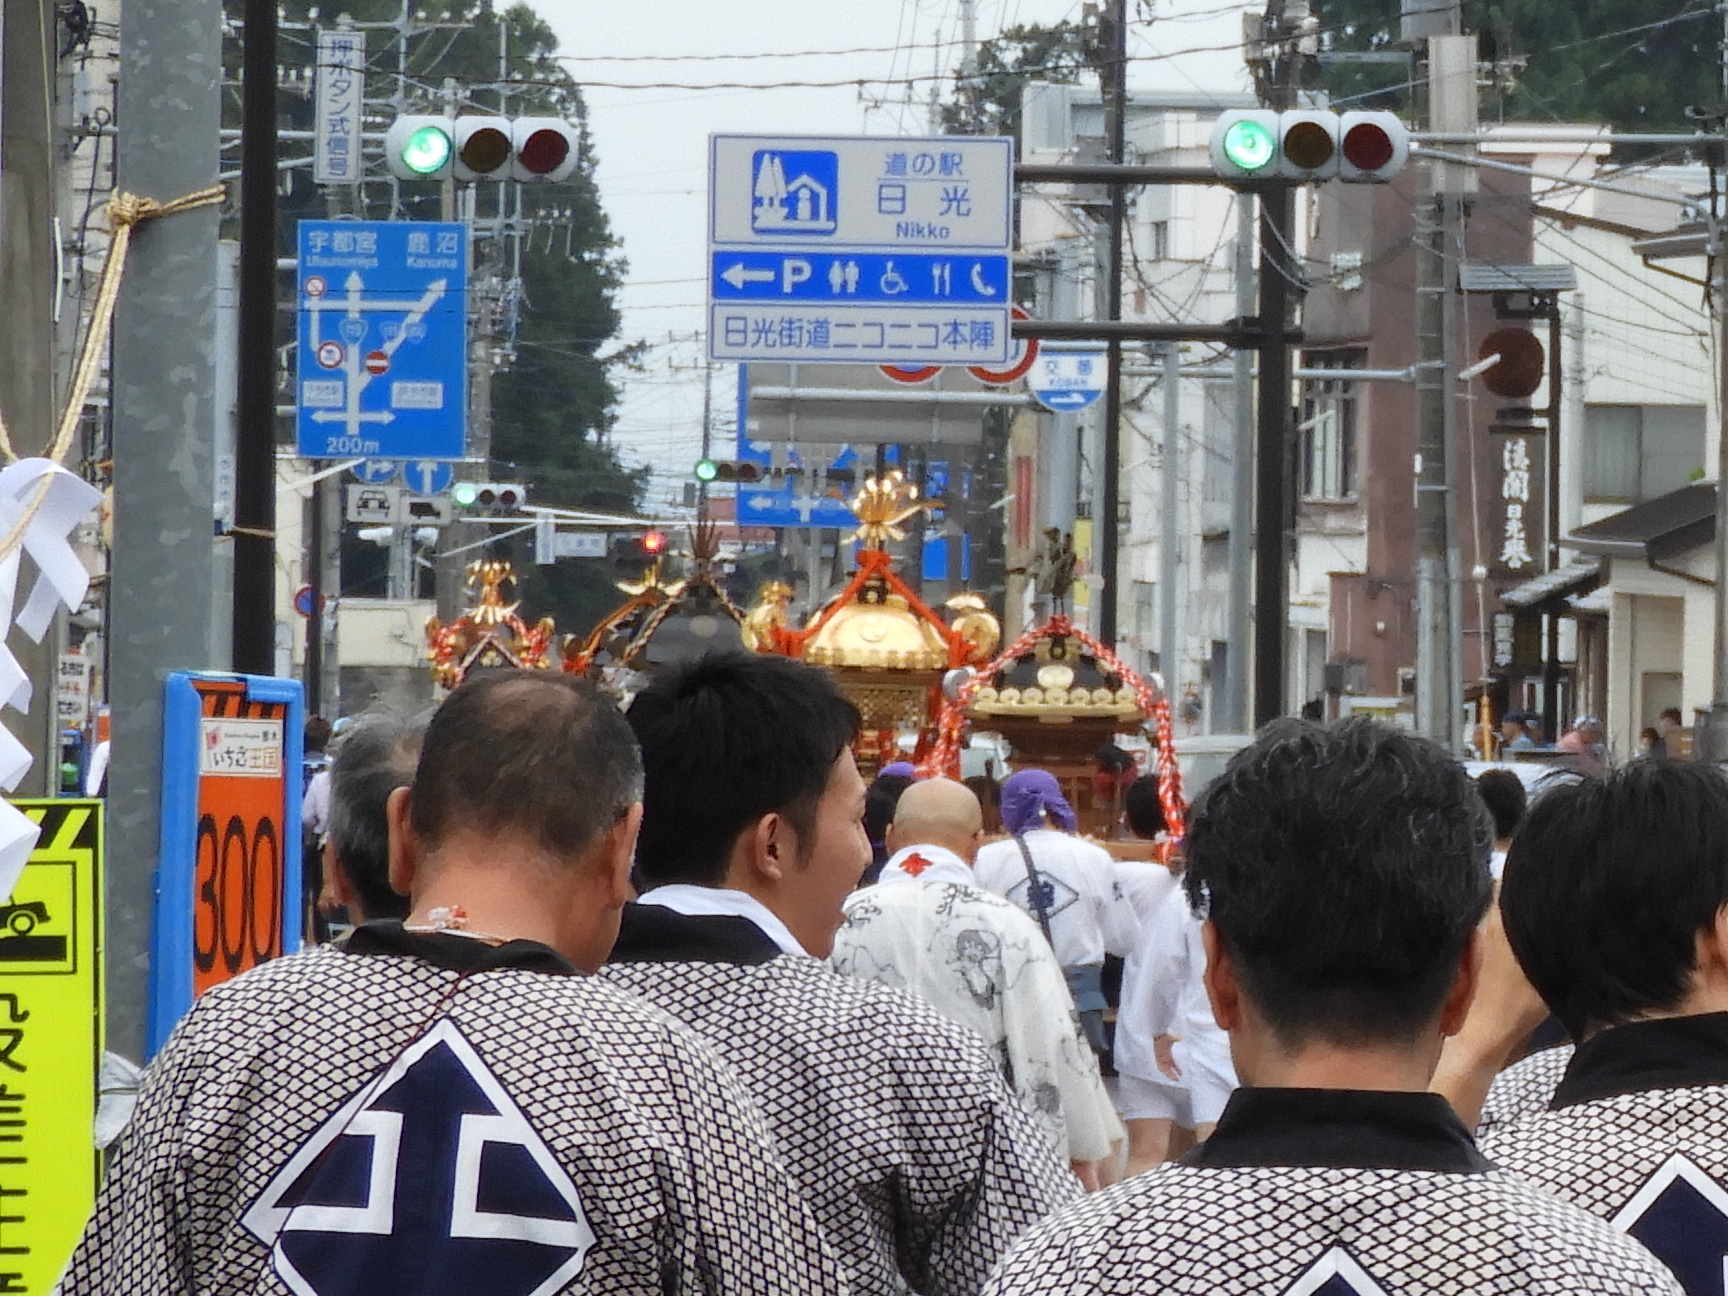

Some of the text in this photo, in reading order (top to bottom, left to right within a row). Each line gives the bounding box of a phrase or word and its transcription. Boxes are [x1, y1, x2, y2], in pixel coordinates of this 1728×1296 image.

[326, 39, 353, 176] 押ボタン式信号
[886, 153, 964, 176] 道の駅
[878, 184, 972, 217] 日光
[308, 230, 458, 254] 宇都宮 鹿沼
[896, 222, 951, 240] Nikko
[407, 256, 457, 269] Kanuma
[783, 259, 812, 294] P
[725, 317, 995, 351] 日光街道ニコニコ本陣
[327, 437, 380, 454] 200m
[195, 814, 278, 973] 300
